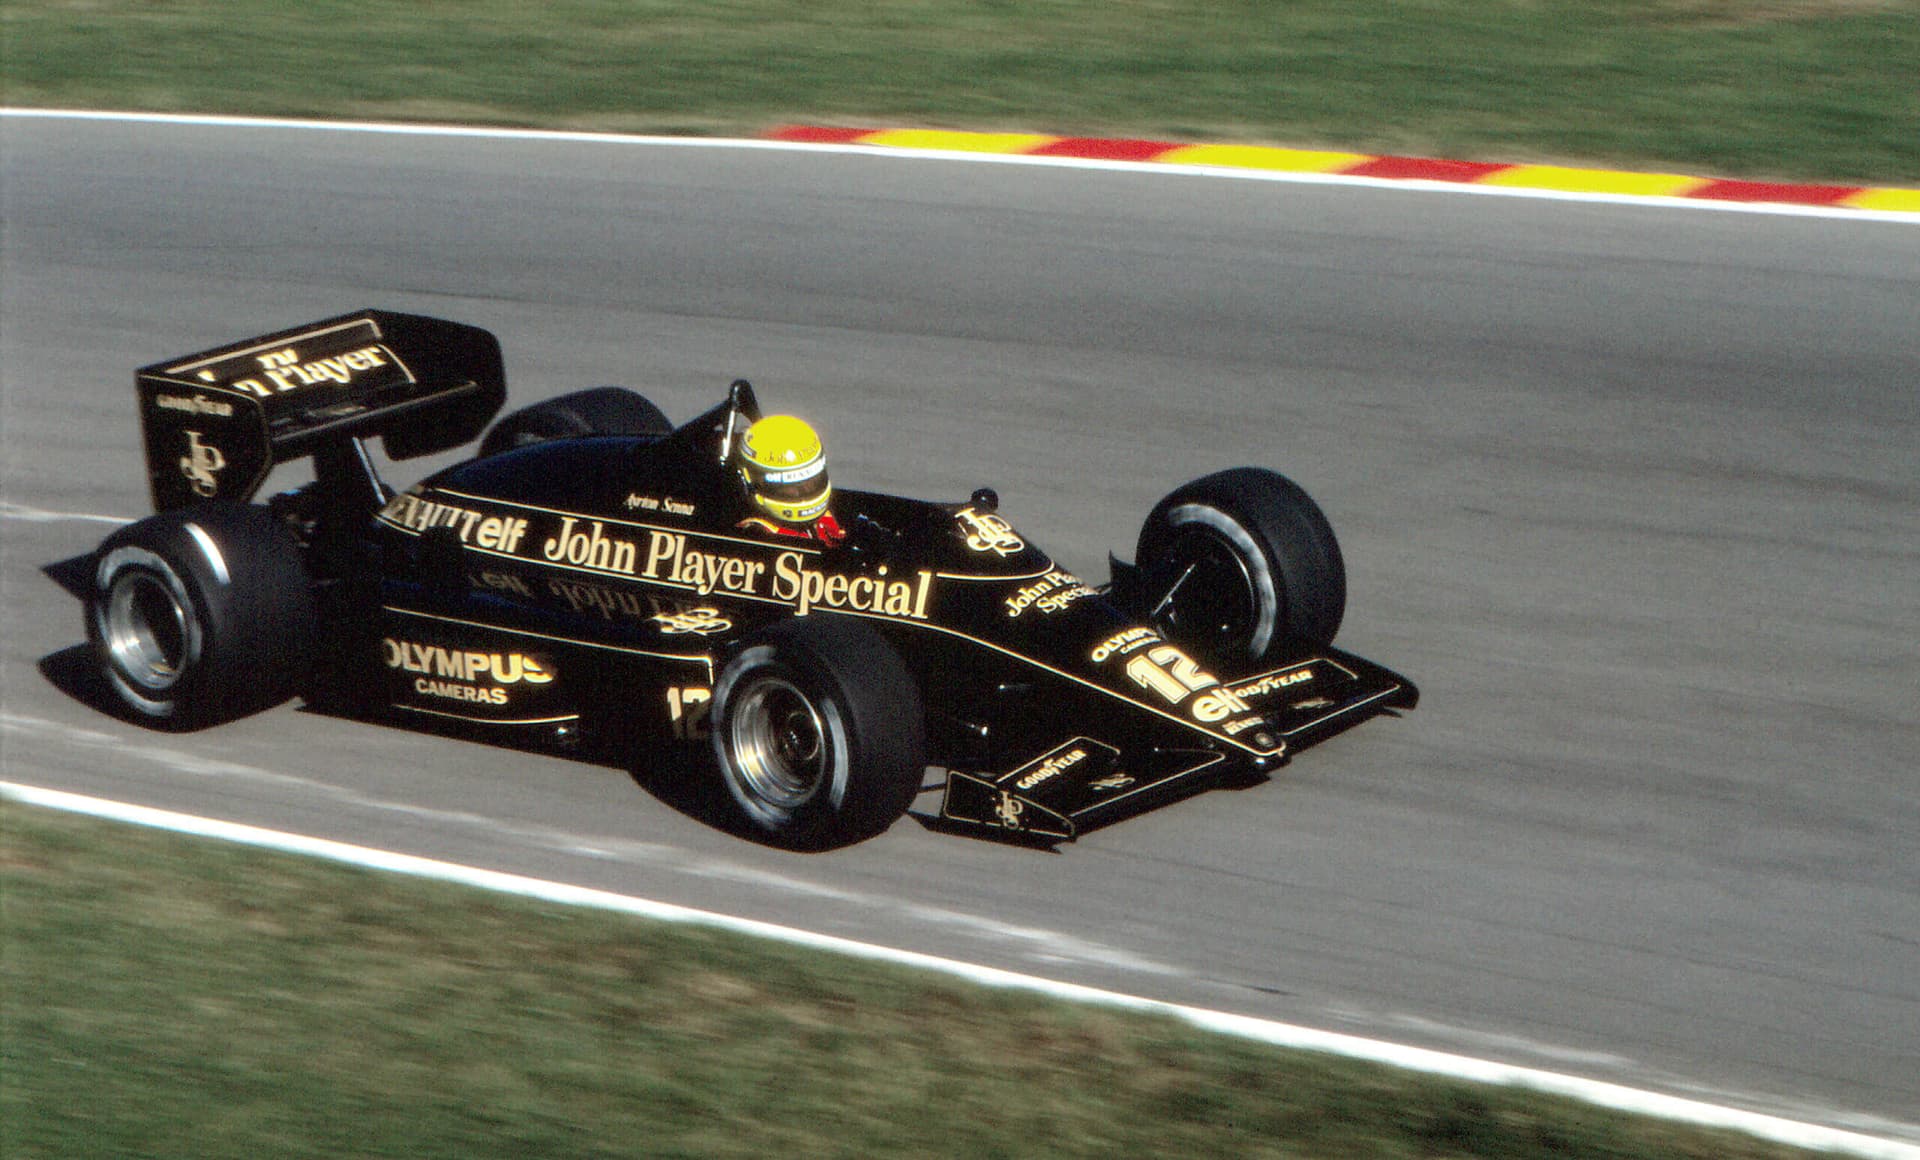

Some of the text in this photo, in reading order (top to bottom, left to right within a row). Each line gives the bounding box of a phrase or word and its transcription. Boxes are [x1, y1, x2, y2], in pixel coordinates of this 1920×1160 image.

[476, 516, 529, 553] elf
[544, 517, 636, 575] John
[641, 530, 766, 597] Player
[771, 551, 931, 621] Special
[1005, 577, 1053, 617] John
[415, 678, 509, 705] CAMERAS
[1126, 646, 1220, 705] 12
[1235, 669, 1313, 696] ODYEAR
